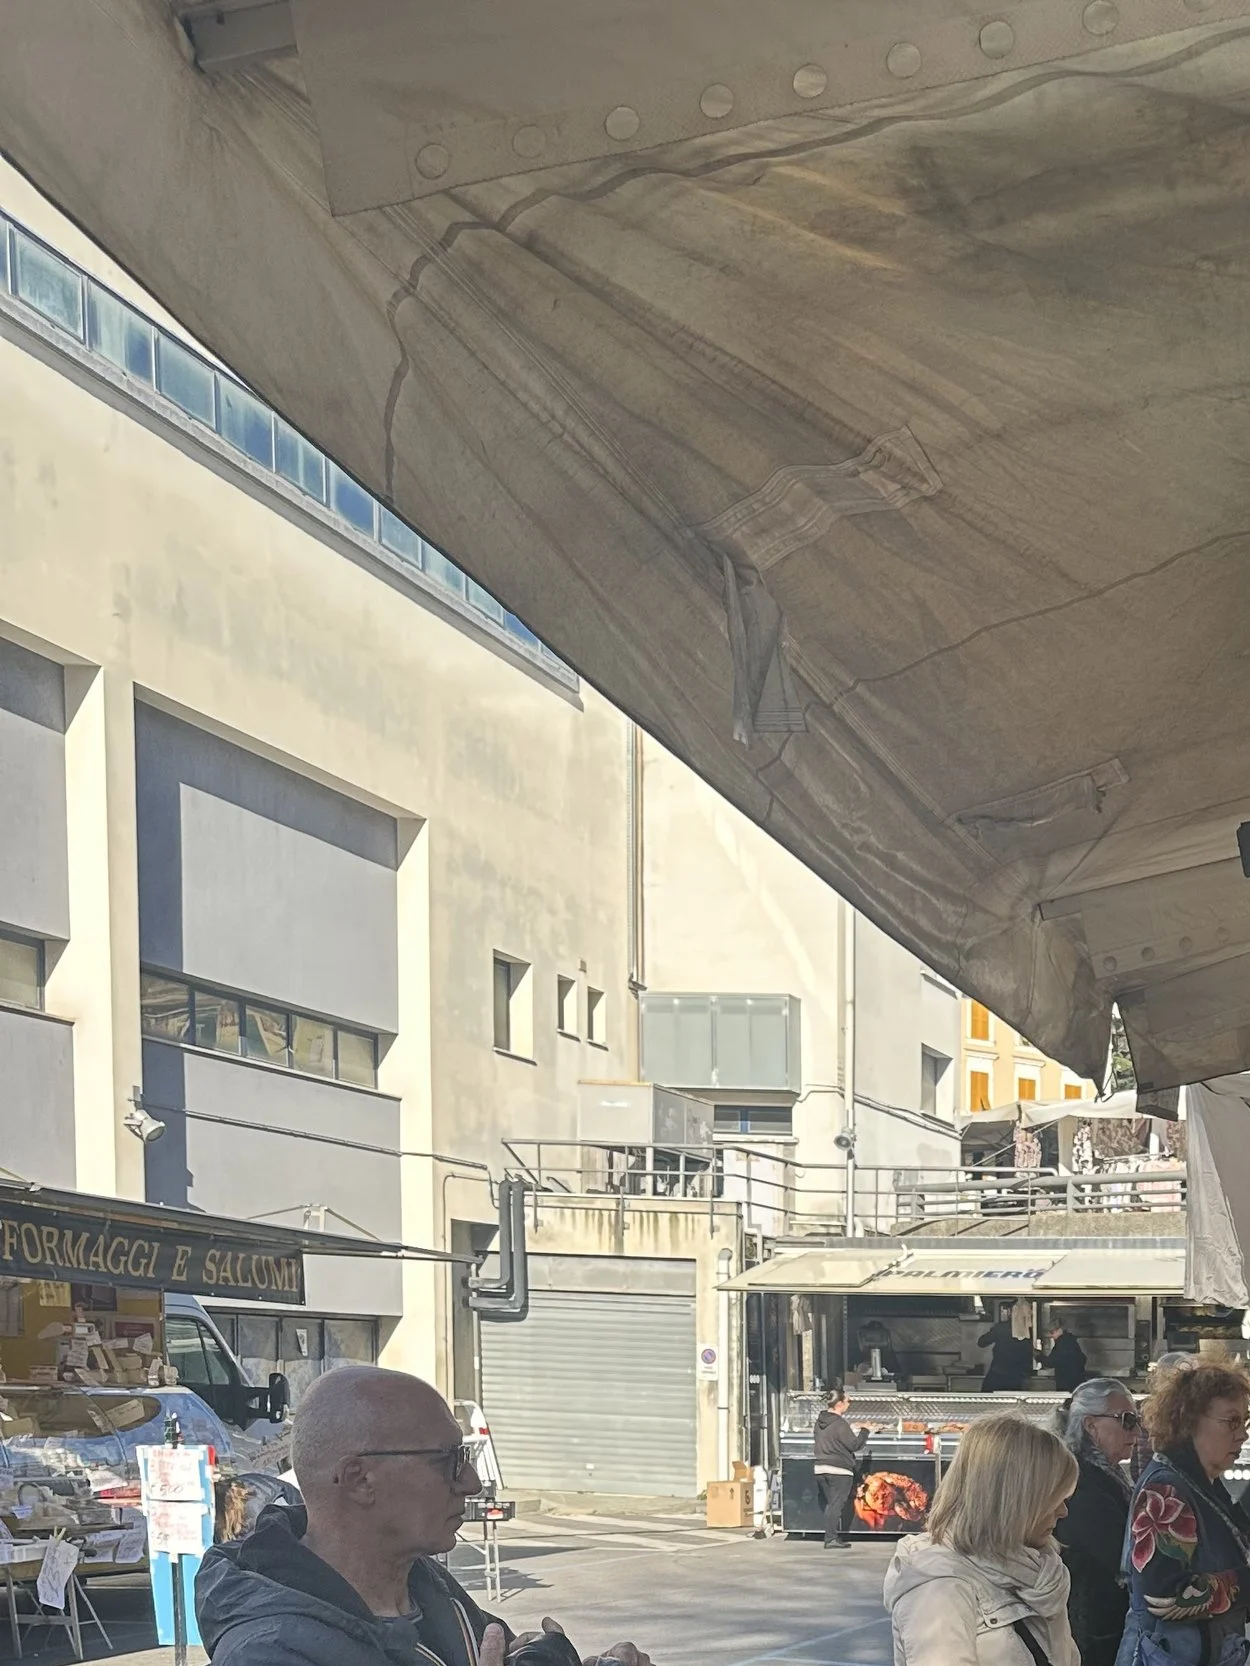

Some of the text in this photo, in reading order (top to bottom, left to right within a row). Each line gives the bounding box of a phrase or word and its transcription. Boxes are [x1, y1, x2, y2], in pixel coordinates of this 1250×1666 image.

[2, 1219, 300, 1292] FORMAGGI E SALUMI
